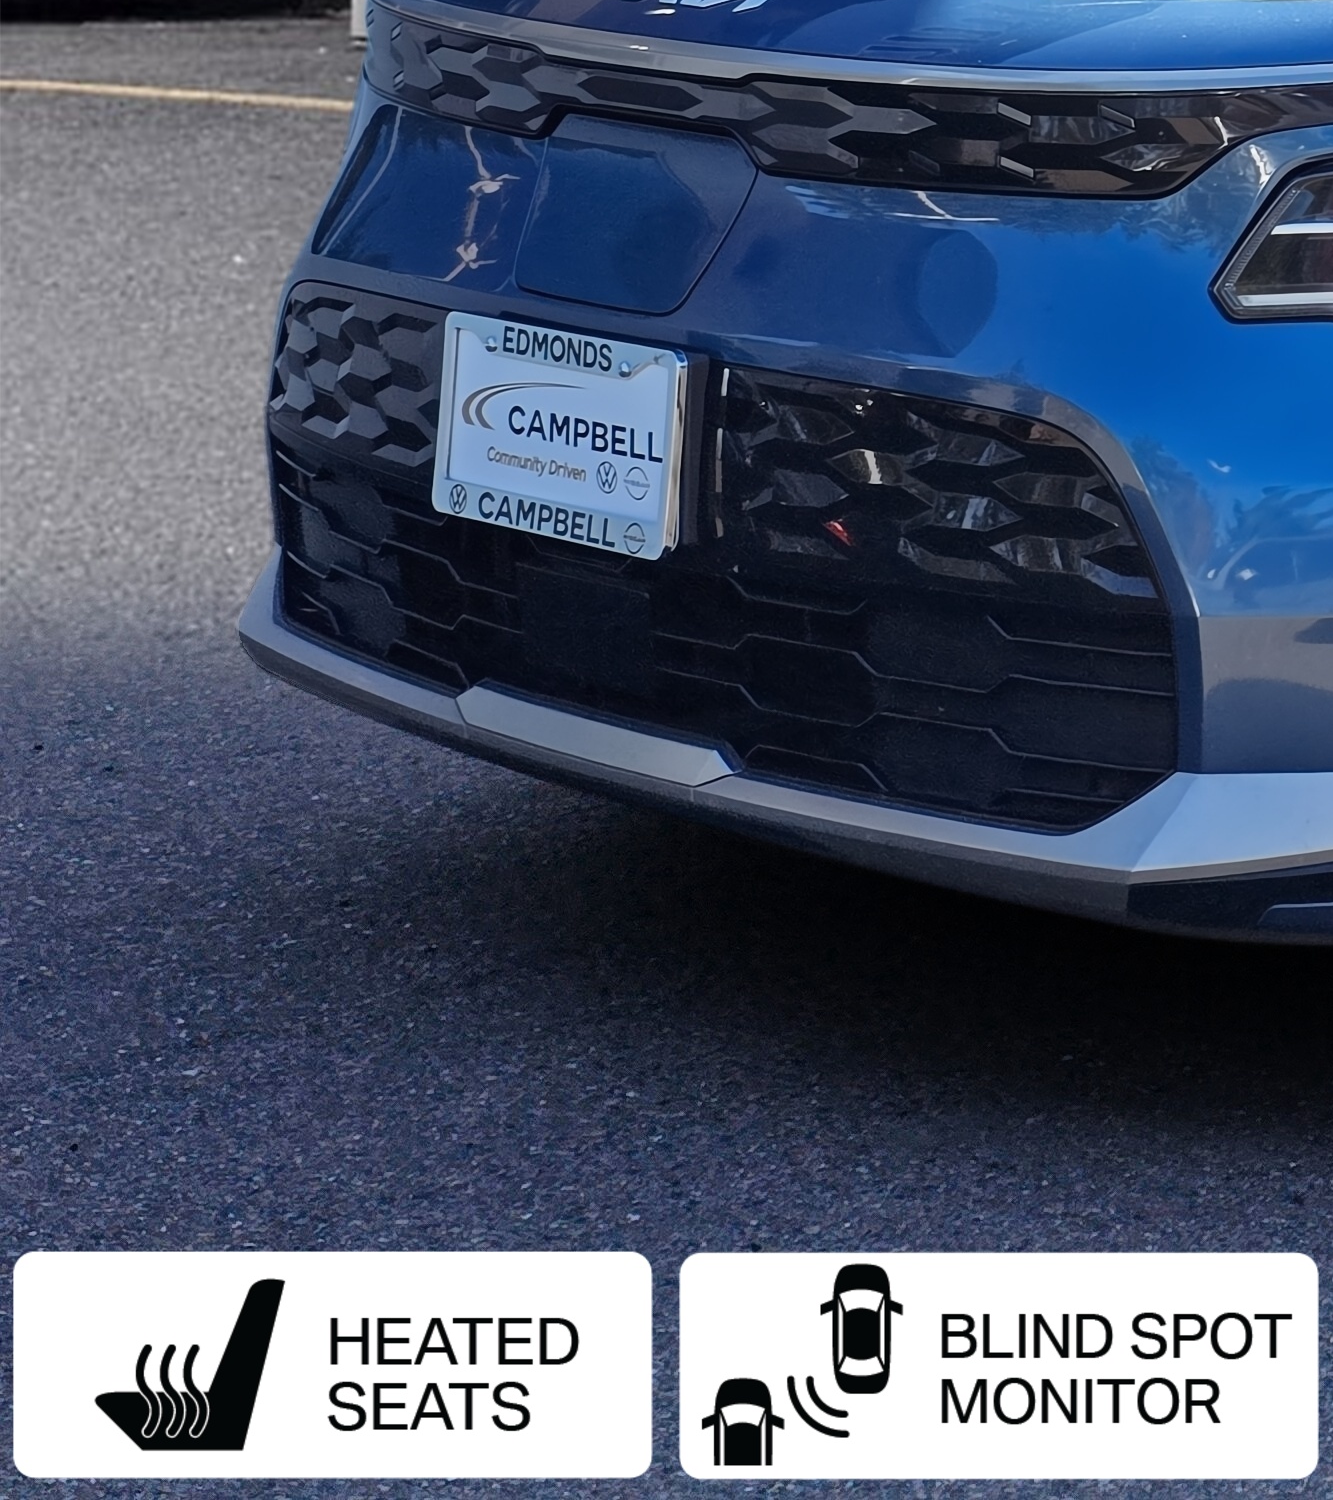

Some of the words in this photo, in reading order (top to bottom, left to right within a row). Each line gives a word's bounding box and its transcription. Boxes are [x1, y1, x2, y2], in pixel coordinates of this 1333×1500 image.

[502, 326, 613, 372] EDMONDS
[508, 405, 664, 464] CAMPBELL
[487, 445, 547, 478] Community
[548, 459, 587, 483] Driven
[478, 491, 615, 548] CAMPBELL
